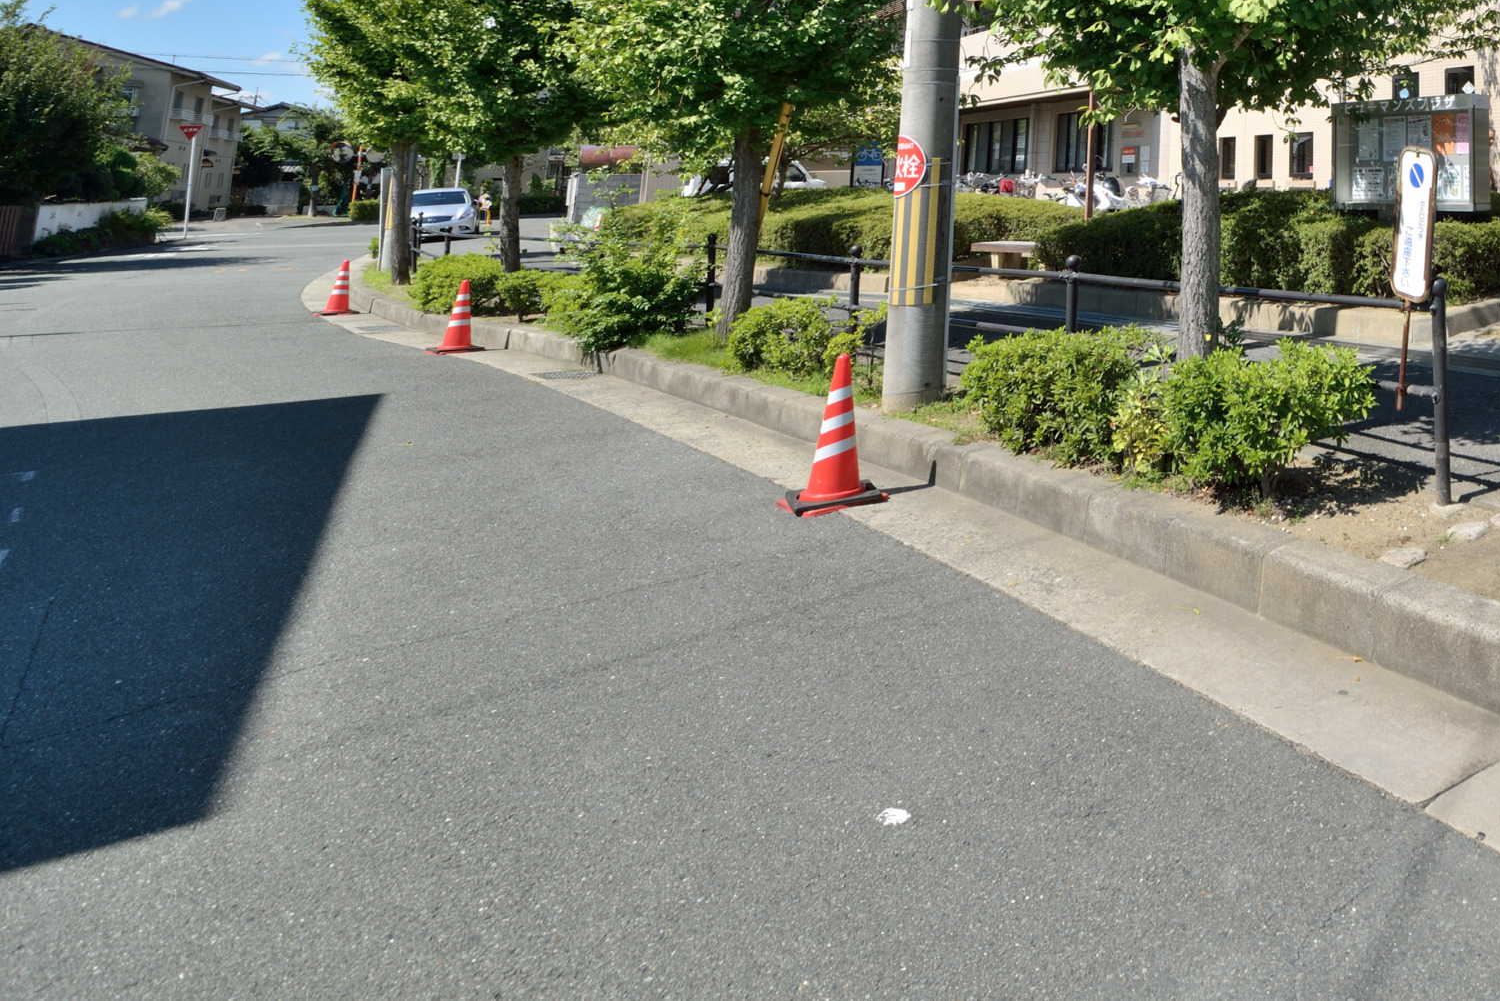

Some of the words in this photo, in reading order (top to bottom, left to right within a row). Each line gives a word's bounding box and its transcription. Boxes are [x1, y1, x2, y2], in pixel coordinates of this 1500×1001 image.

[1344, 95, 1456, 114] ヒューマンズプラザ
[895, 154, 921, 178] 火栓
